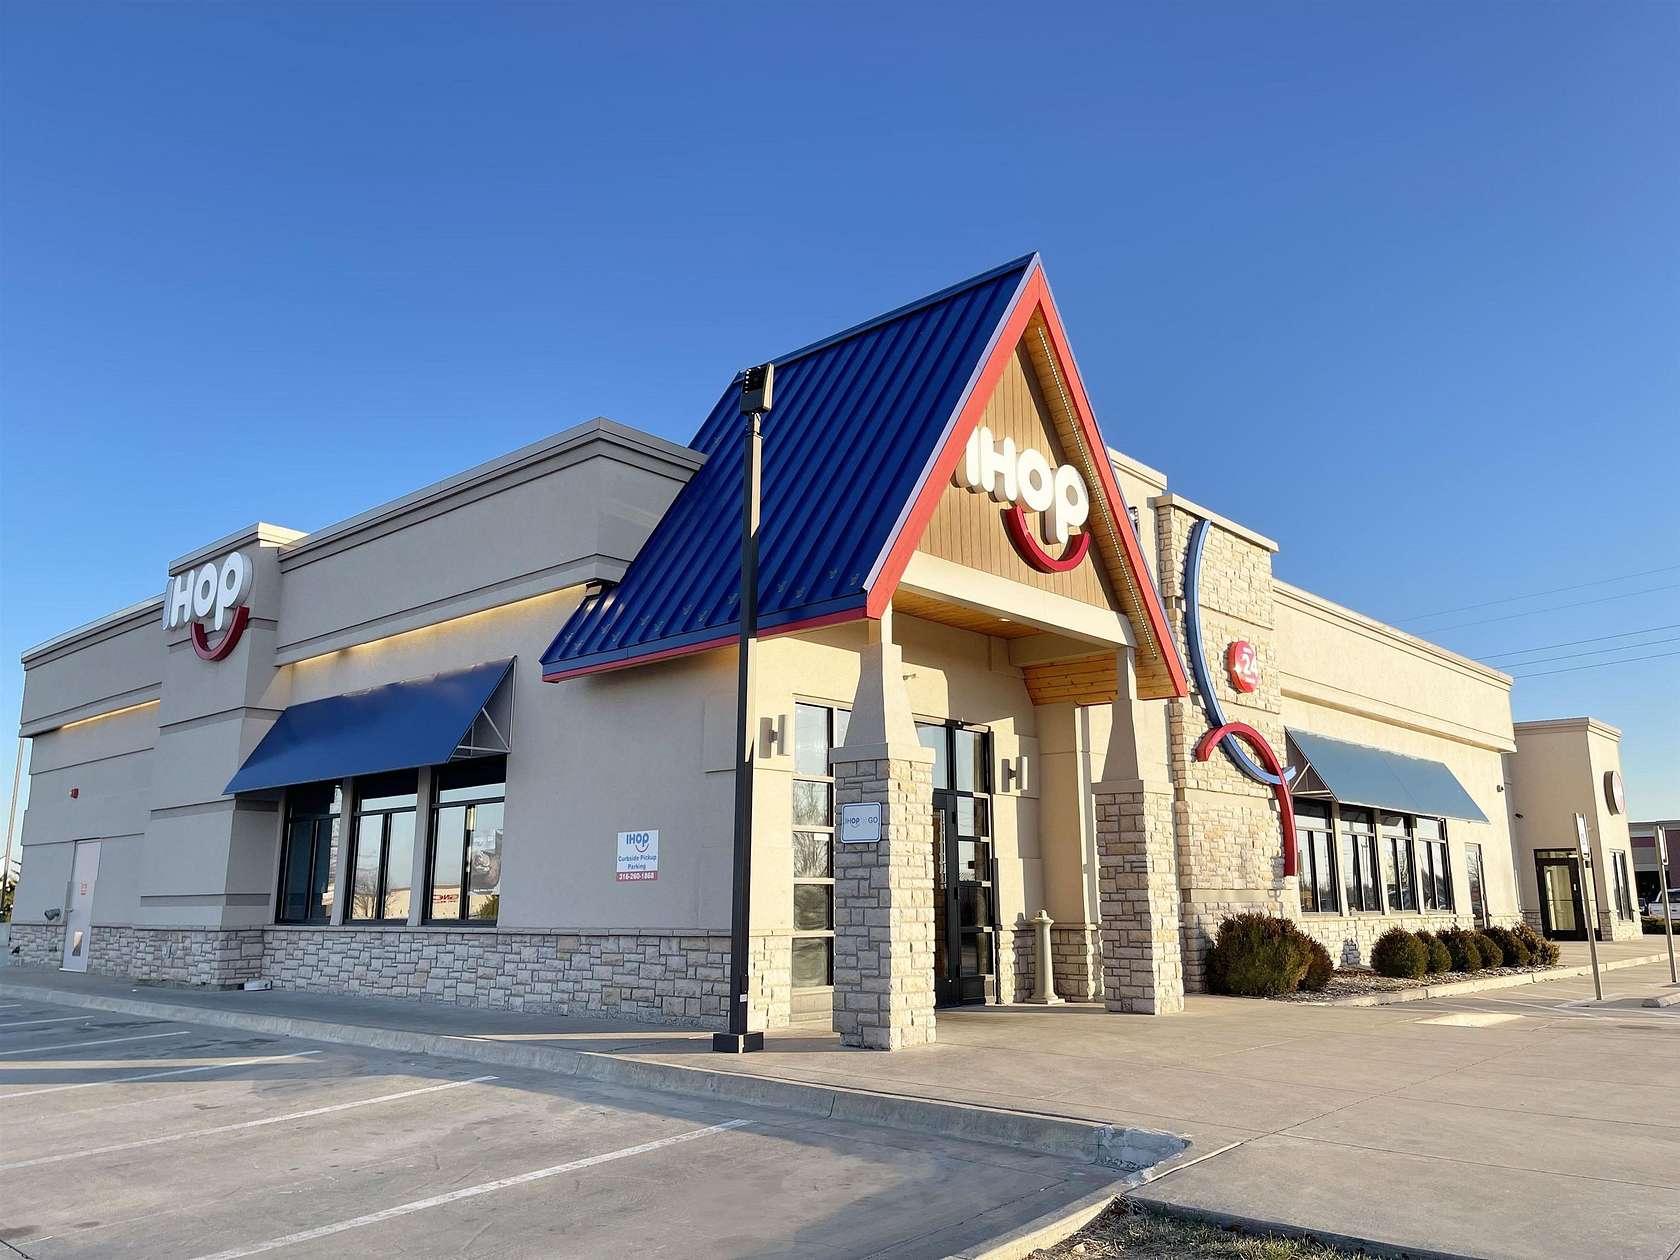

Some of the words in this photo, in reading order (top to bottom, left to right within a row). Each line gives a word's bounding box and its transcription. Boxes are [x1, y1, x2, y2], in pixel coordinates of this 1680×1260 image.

[965, 425, 1090, 545] IHOP
[161, 551, 251, 631] IHOP
[1240, 653, 1258, 676] 24
[868, 816, 879, 824] GO
[626, 832, 650, 847] IHOP
[640, 854, 657, 862] Pickup
